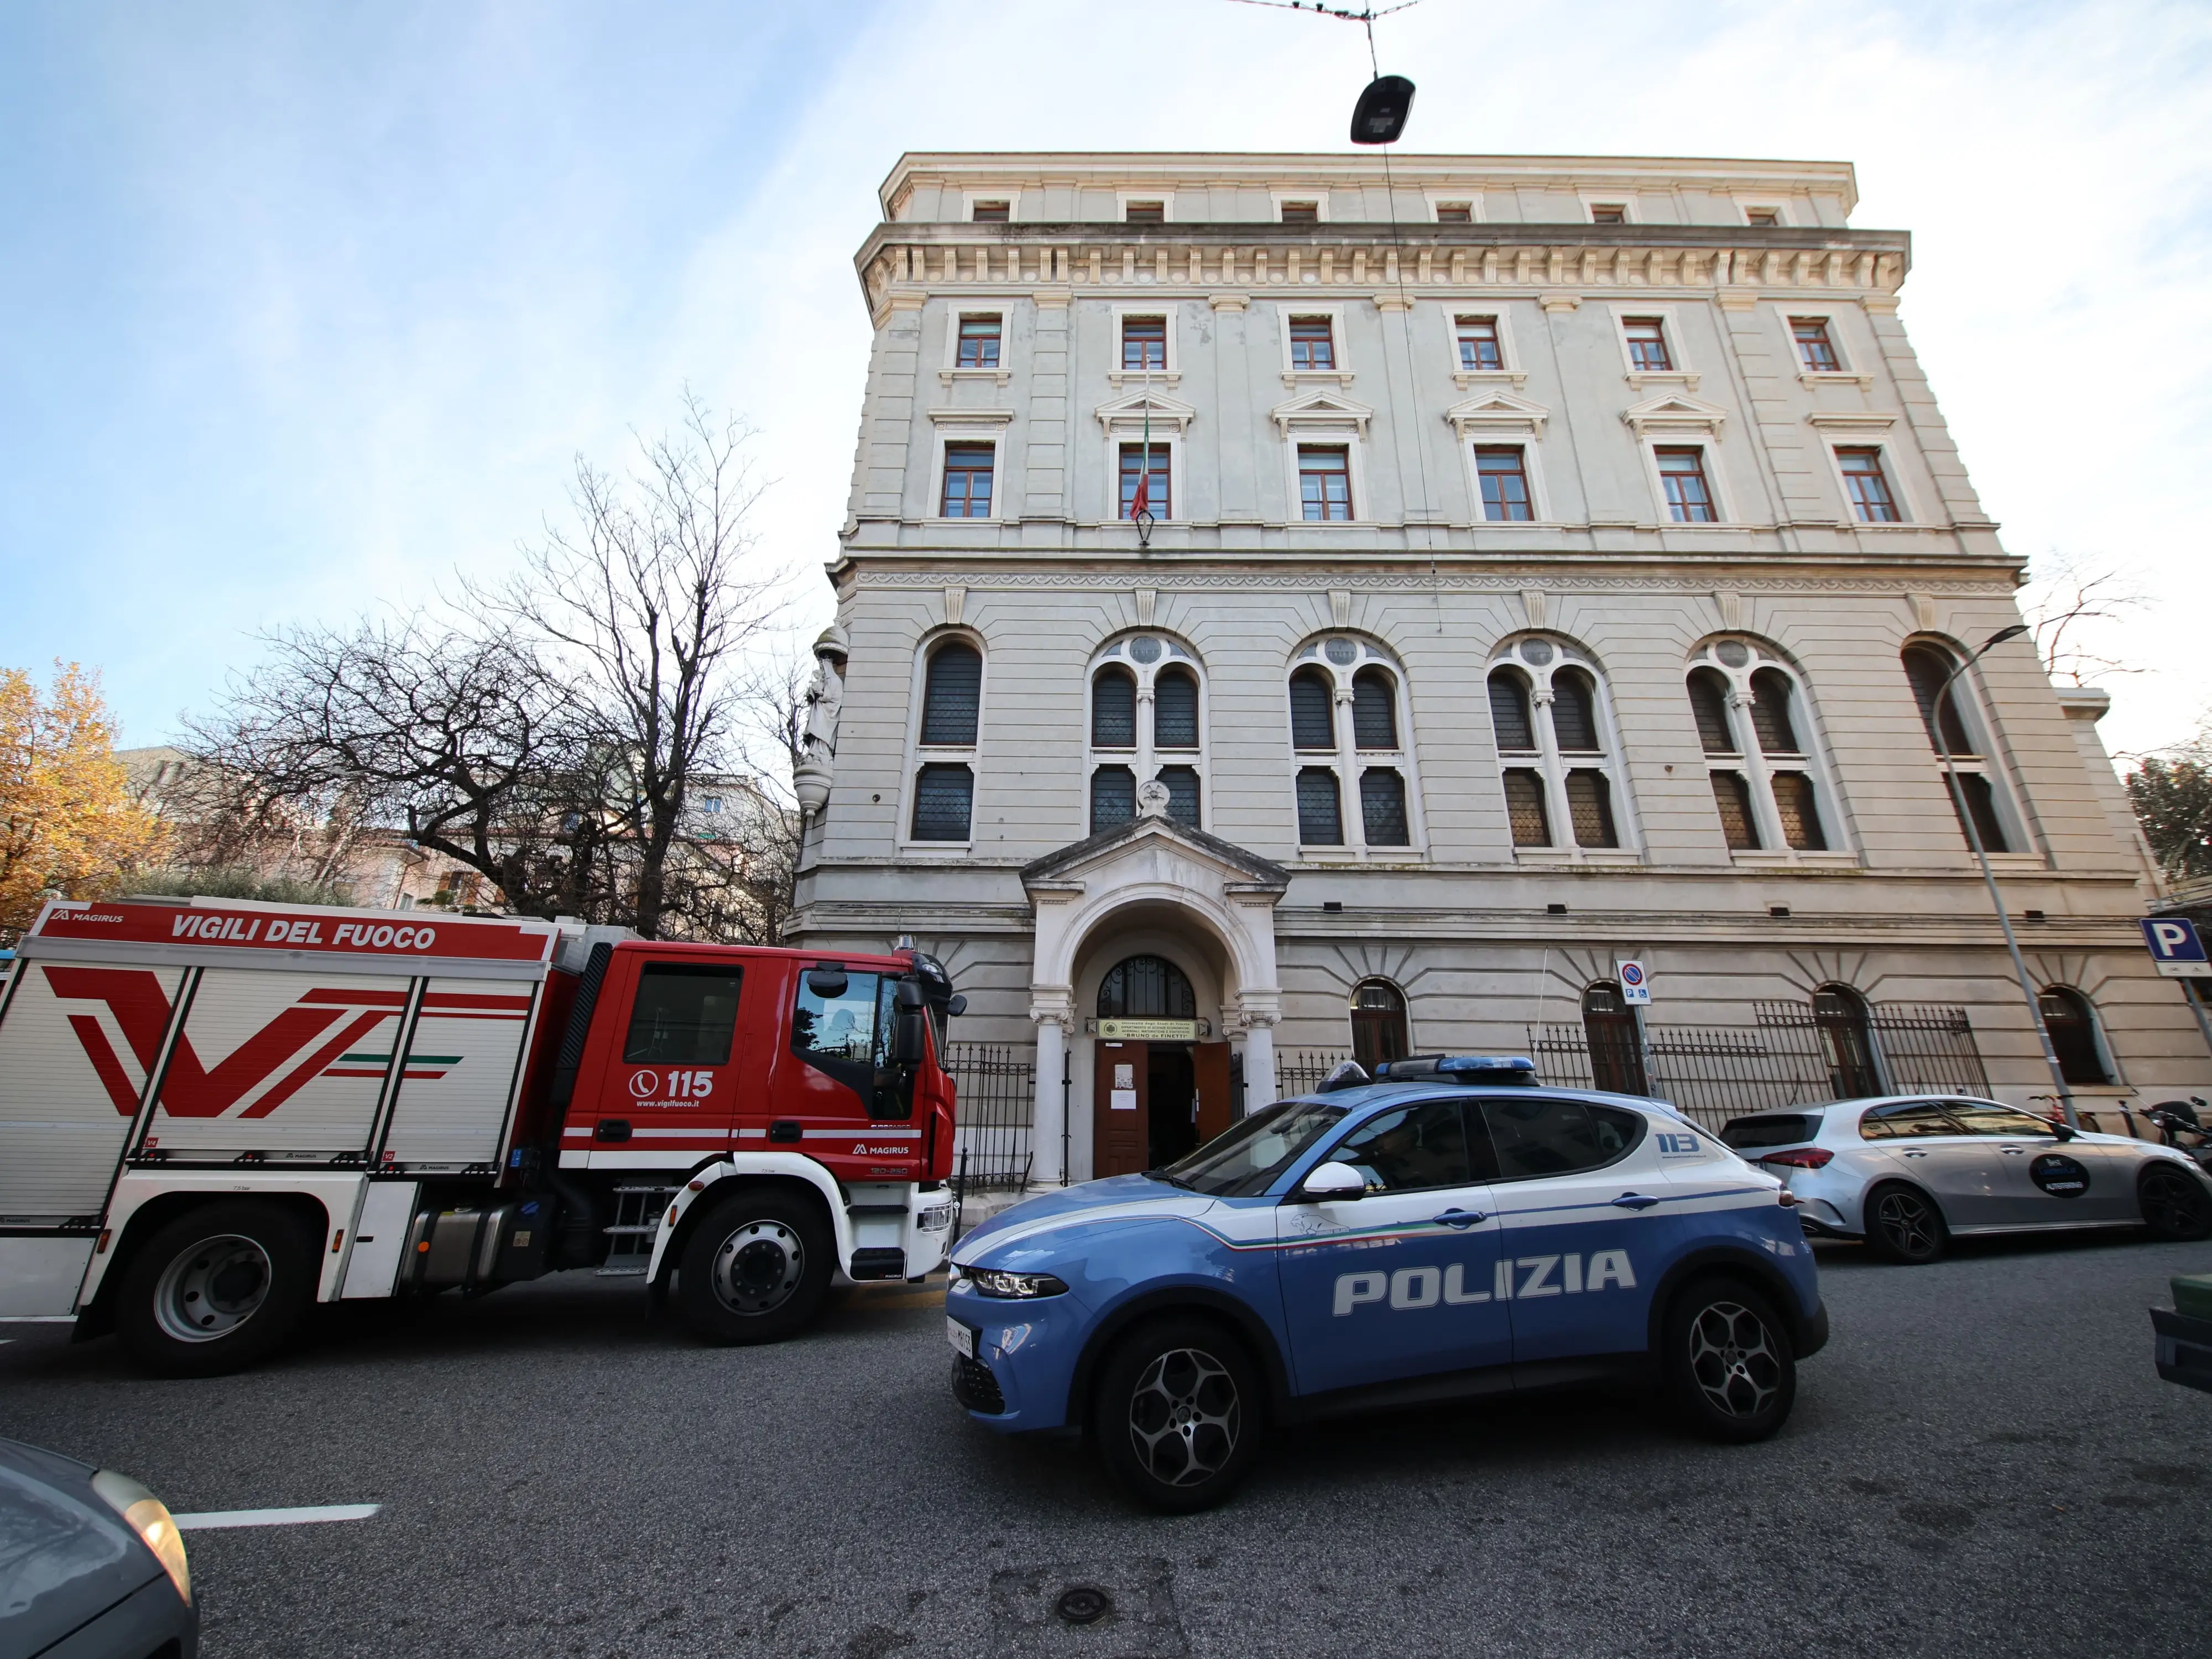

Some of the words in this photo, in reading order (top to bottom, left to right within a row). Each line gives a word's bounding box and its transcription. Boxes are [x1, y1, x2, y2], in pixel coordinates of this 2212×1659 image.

[72, 914, 123, 922] MAGIRUS
[171, 915, 261, 940] VIGILI
[264, 920, 322, 944] DEL
[332, 924, 436, 950] FUOCO
[2151, 923, 2187, 956] P
[668, 1071, 713, 1098] 115
[637, 1100, 699, 1108] www.vigilfuoco.it
[1655, 1134, 1700, 1152] 113
[1332, 1248, 1637, 1316] POLIZIA
